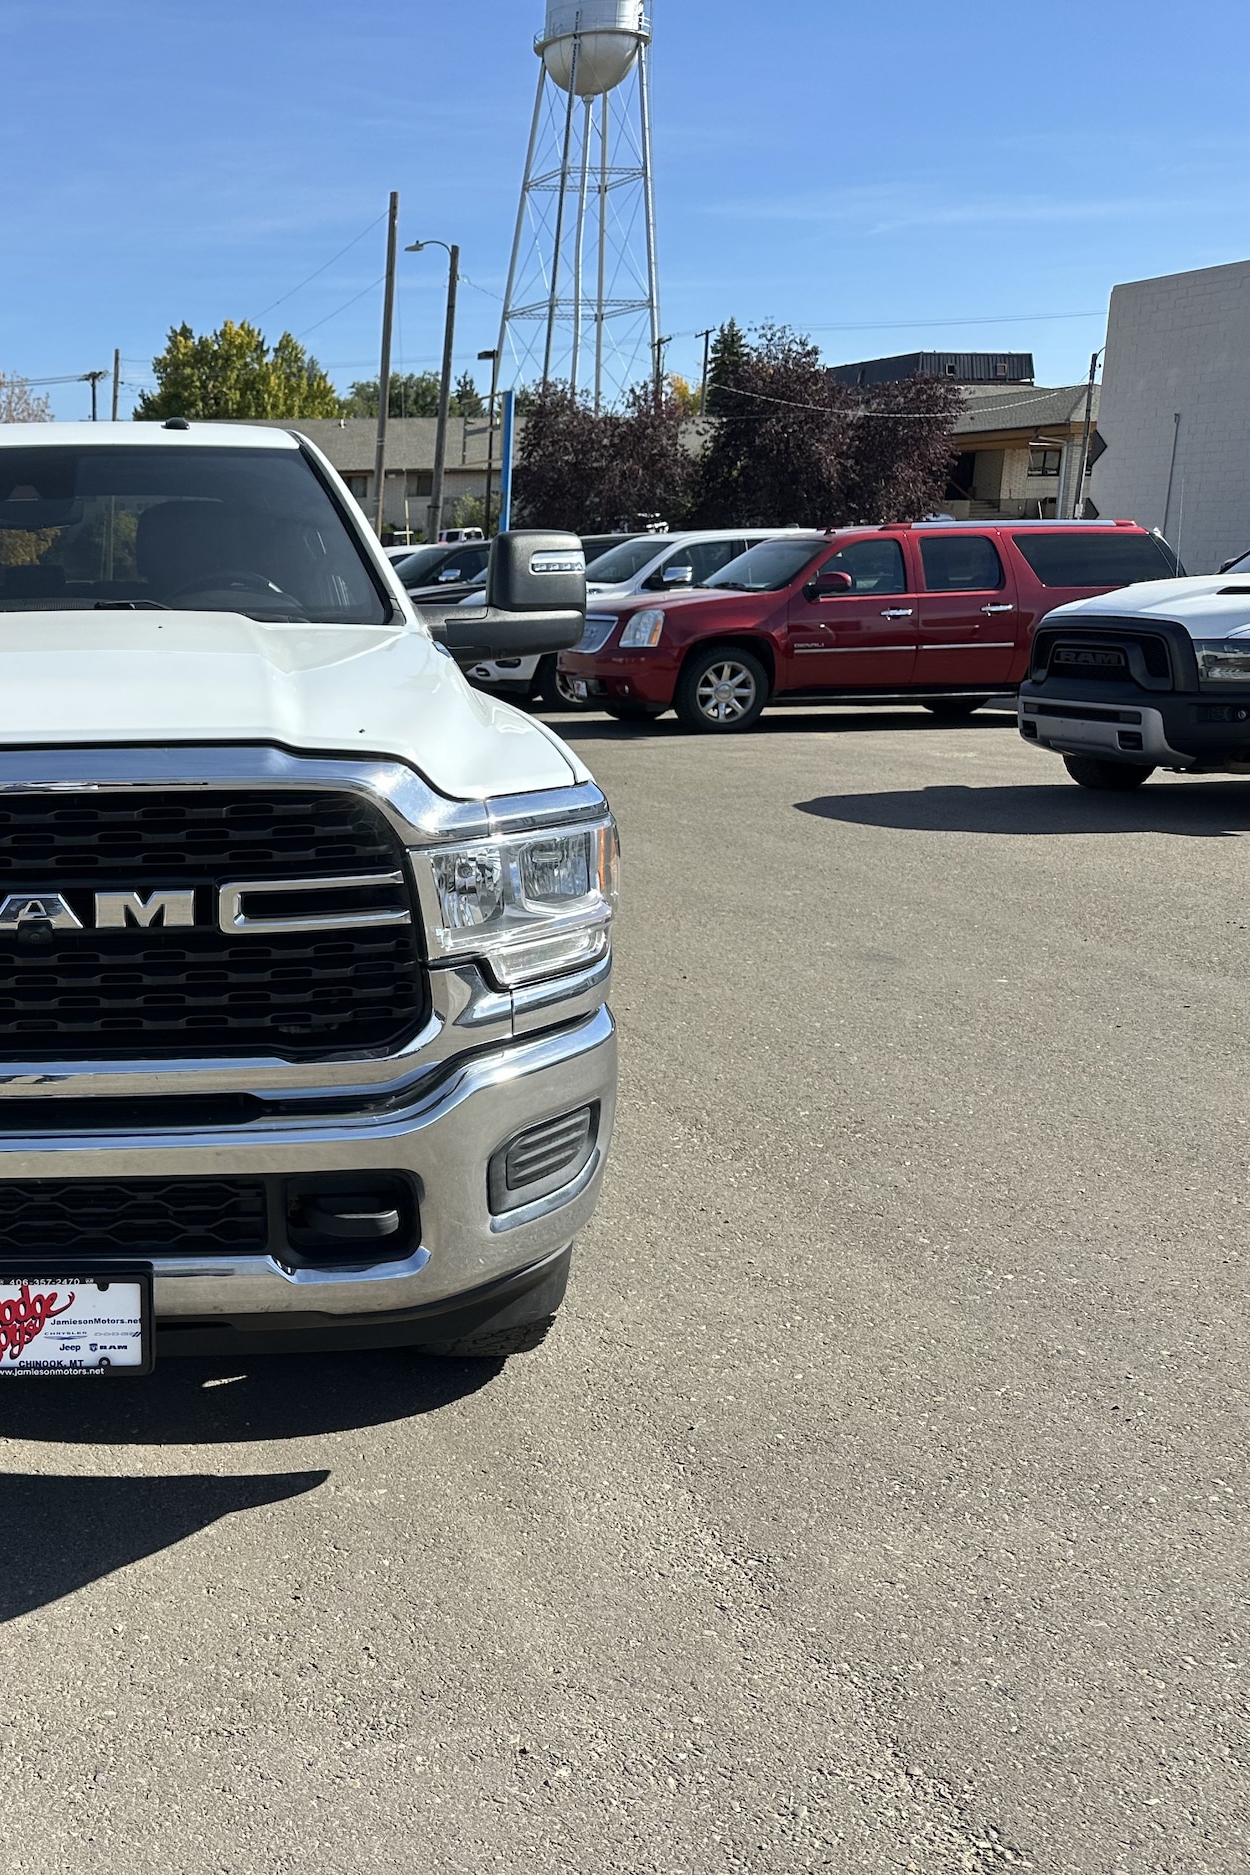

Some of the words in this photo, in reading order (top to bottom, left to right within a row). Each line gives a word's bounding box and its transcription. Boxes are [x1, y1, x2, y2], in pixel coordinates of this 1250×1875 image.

[1060, 651, 1119, 665] RAM
[9, 1278, 80, 1286] 406-357-2470
[59, 1343, 81, 1352] Jeep
